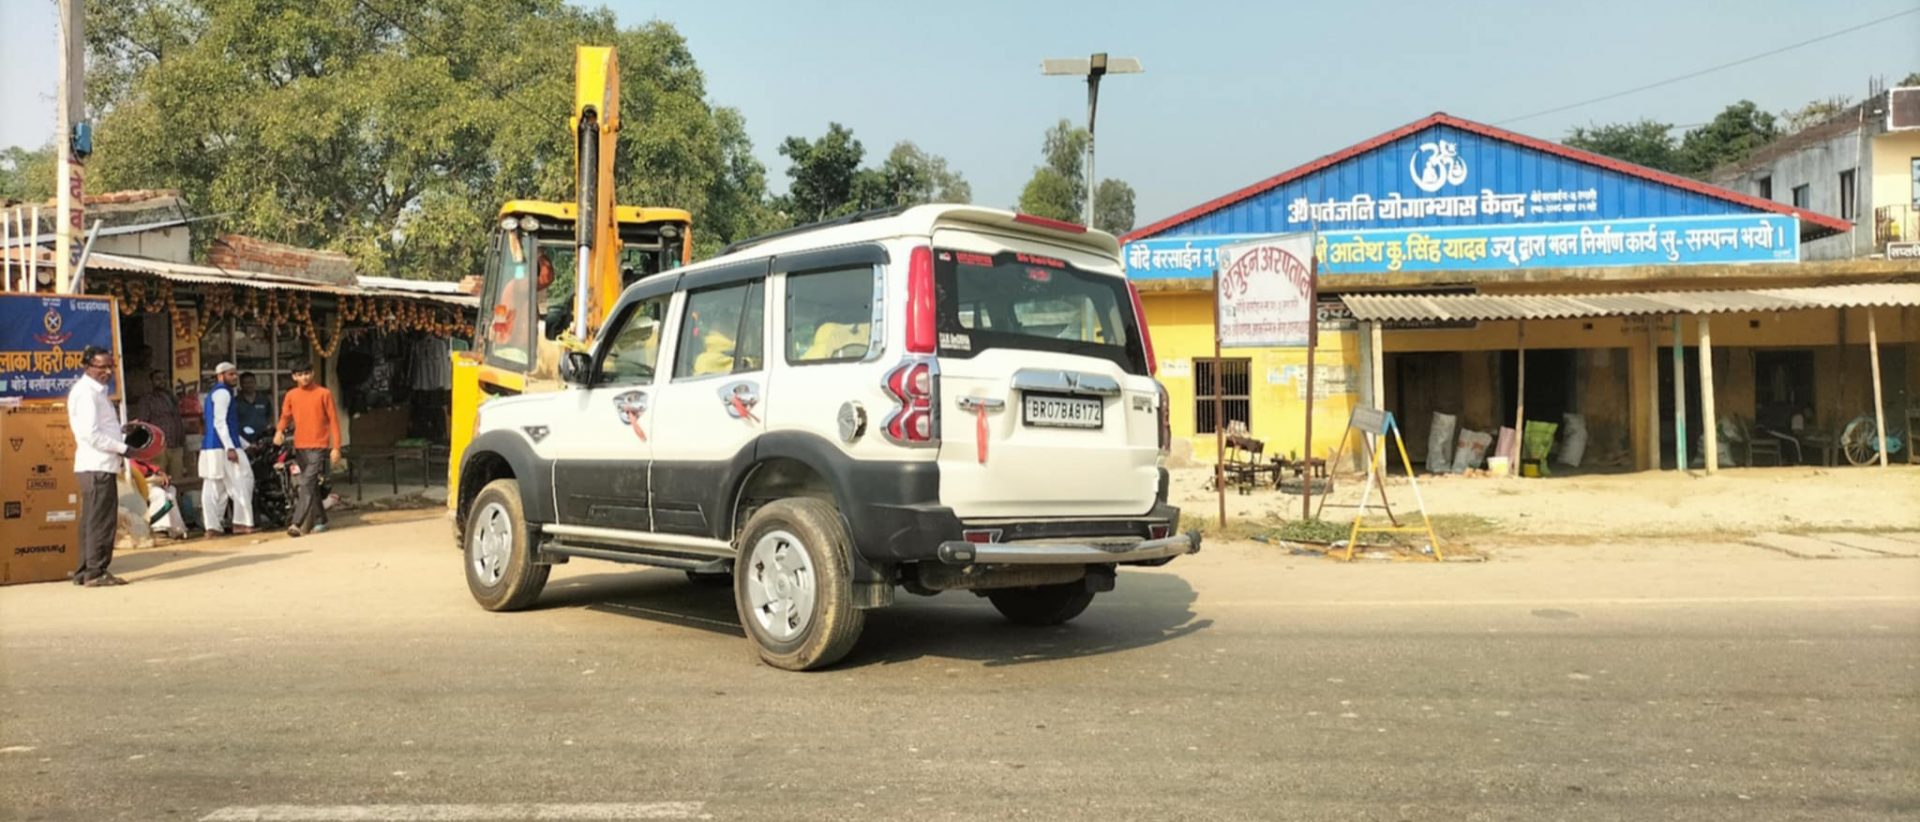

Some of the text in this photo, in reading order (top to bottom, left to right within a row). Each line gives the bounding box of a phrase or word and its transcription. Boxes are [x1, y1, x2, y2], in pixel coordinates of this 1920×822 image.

[1378, 192, 1478, 220] योगाभ्यास
[1480, 189, 1527, 218] केन्द्र
[1129, 244, 1150, 271] बोदे
[1443, 238, 1488, 261] यादव
[1032, 400, 1101, 421] BR07BA8172
[15, 544, 66, 555] Panasonic
